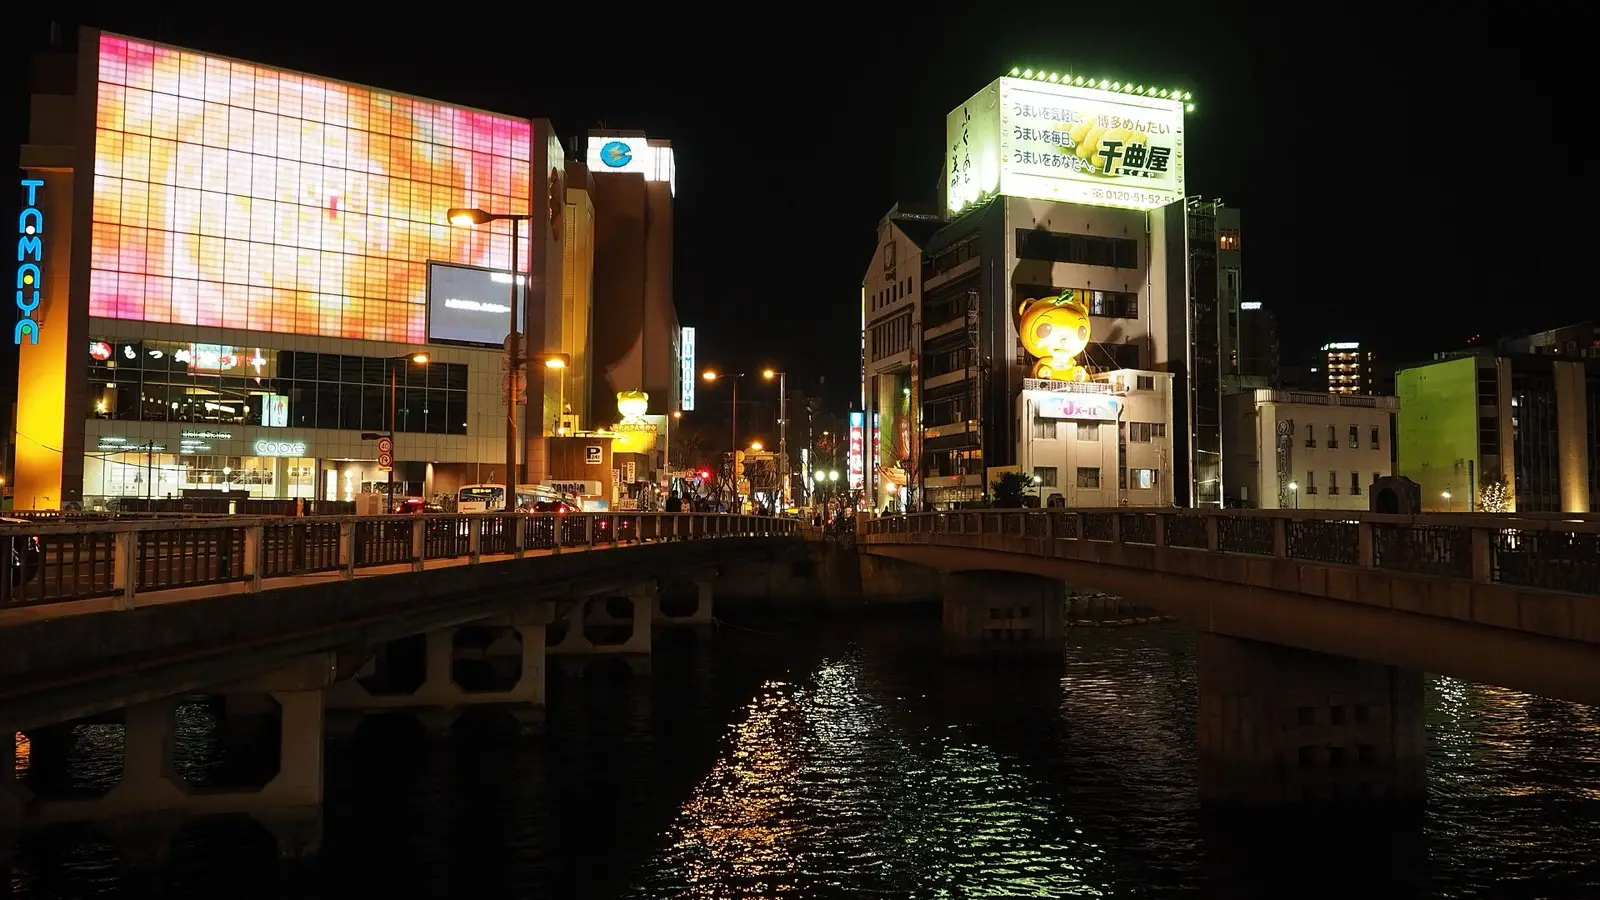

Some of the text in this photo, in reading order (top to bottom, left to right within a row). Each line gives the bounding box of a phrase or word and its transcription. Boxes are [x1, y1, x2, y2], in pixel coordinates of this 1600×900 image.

[1013, 102, 1083, 123] うまいを気軽に、
[1098, 115, 1170, 134] 博多めんたい
[1013, 125, 1076, 147] うまいを毎日、
[1013, 149, 1096, 172] うまいをあなたへ。
[1098, 141, 1171, 173] 千曲屋
[15, 180, 44, 344] TAMAYA
[586, 447, 601, 460] P
